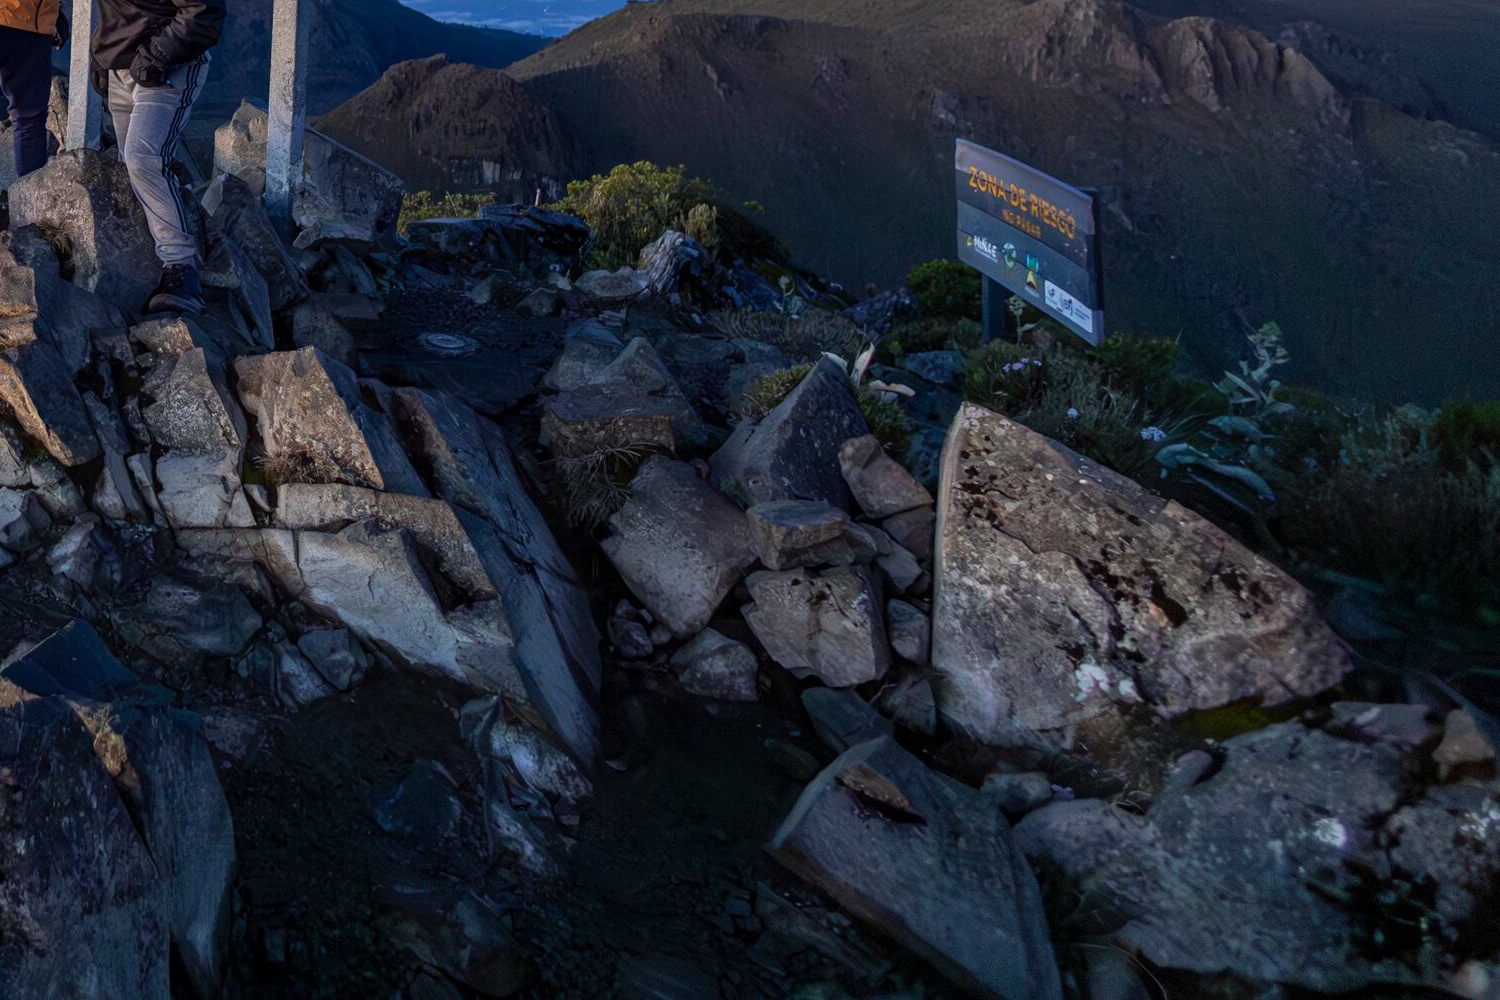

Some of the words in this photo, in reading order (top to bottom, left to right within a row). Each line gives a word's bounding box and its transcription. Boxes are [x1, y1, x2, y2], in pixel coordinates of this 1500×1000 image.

[968, 165, 1007, 201] ZONA
[1010, 183, 1028, 212] DE
[1029, 193, 1076, 240] RIESGO
